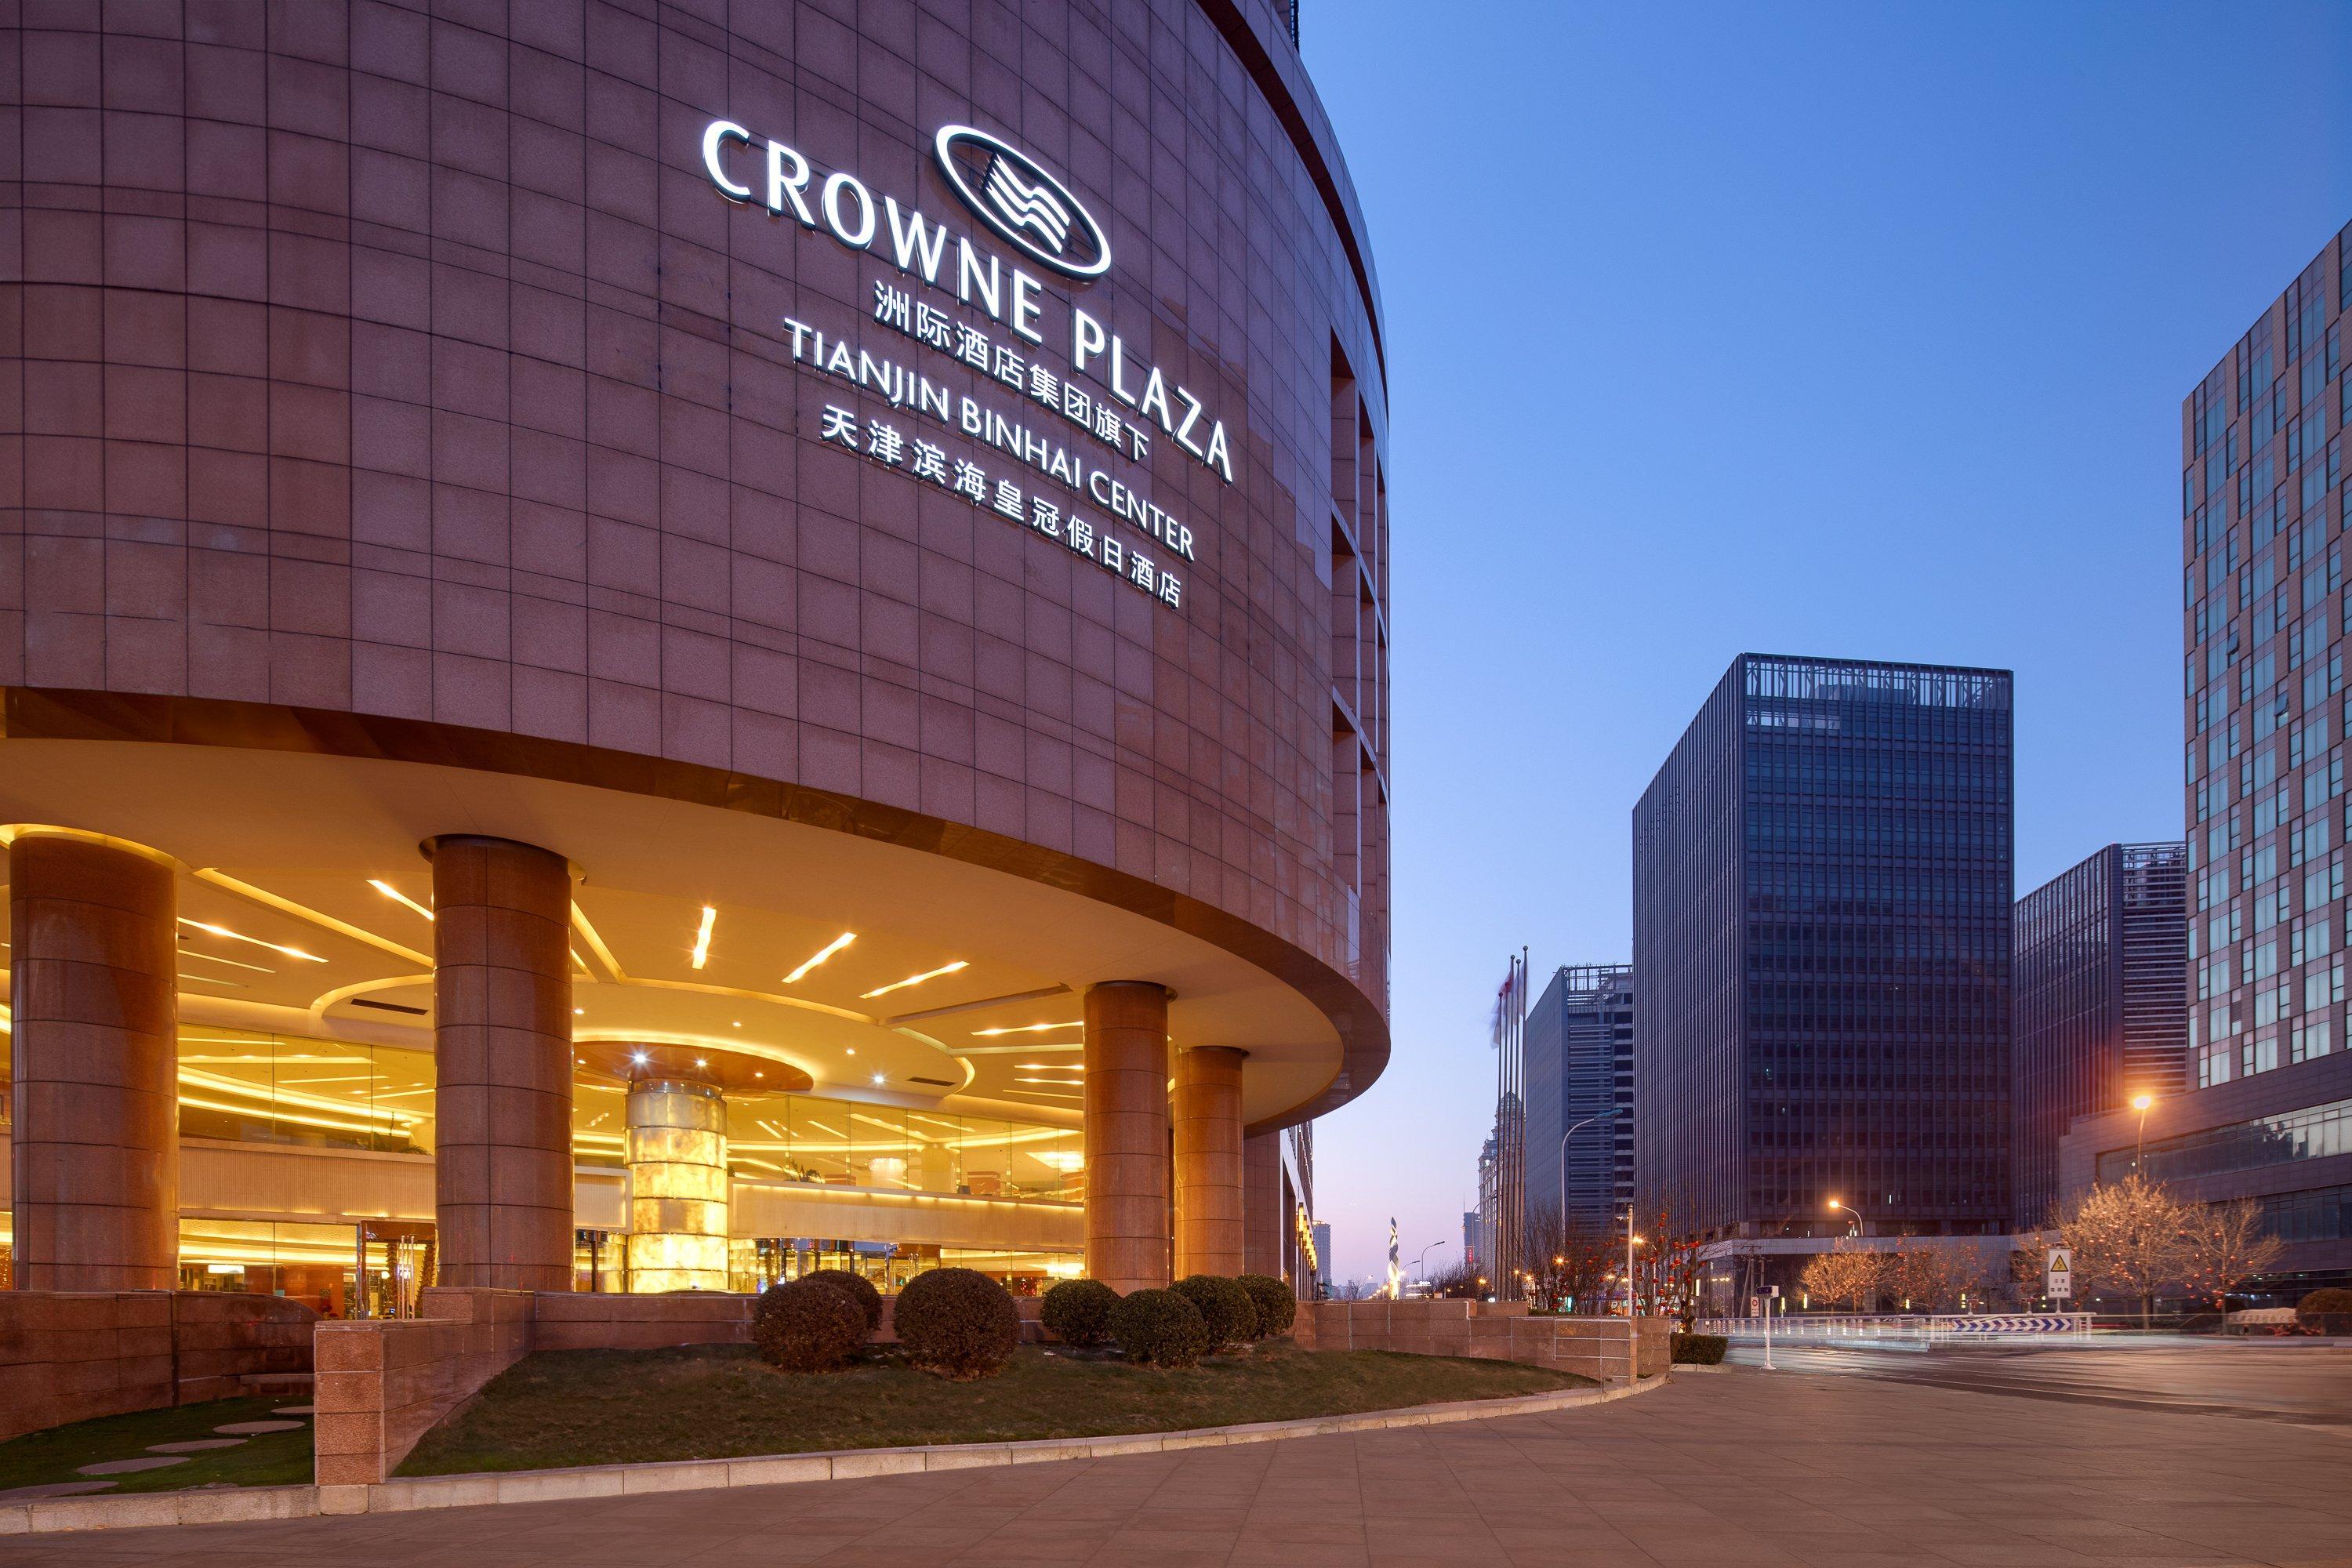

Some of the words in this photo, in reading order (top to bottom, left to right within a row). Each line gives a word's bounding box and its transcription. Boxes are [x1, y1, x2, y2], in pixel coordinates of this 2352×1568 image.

[703, 121, 1044, 343] CROWNE
[1075, 309, 1232, 482] PLAZA
[874, 280, 1149, 461] 洲际酒店集团旗下
[785, 318, 949, 422] TIANJIN
[962, 396, 1080, 489] BINHAI
[1090, 470, 1195, 561] CENTER
[822, 404, 1181, 608] 天津滨海皇冠假日酒店
